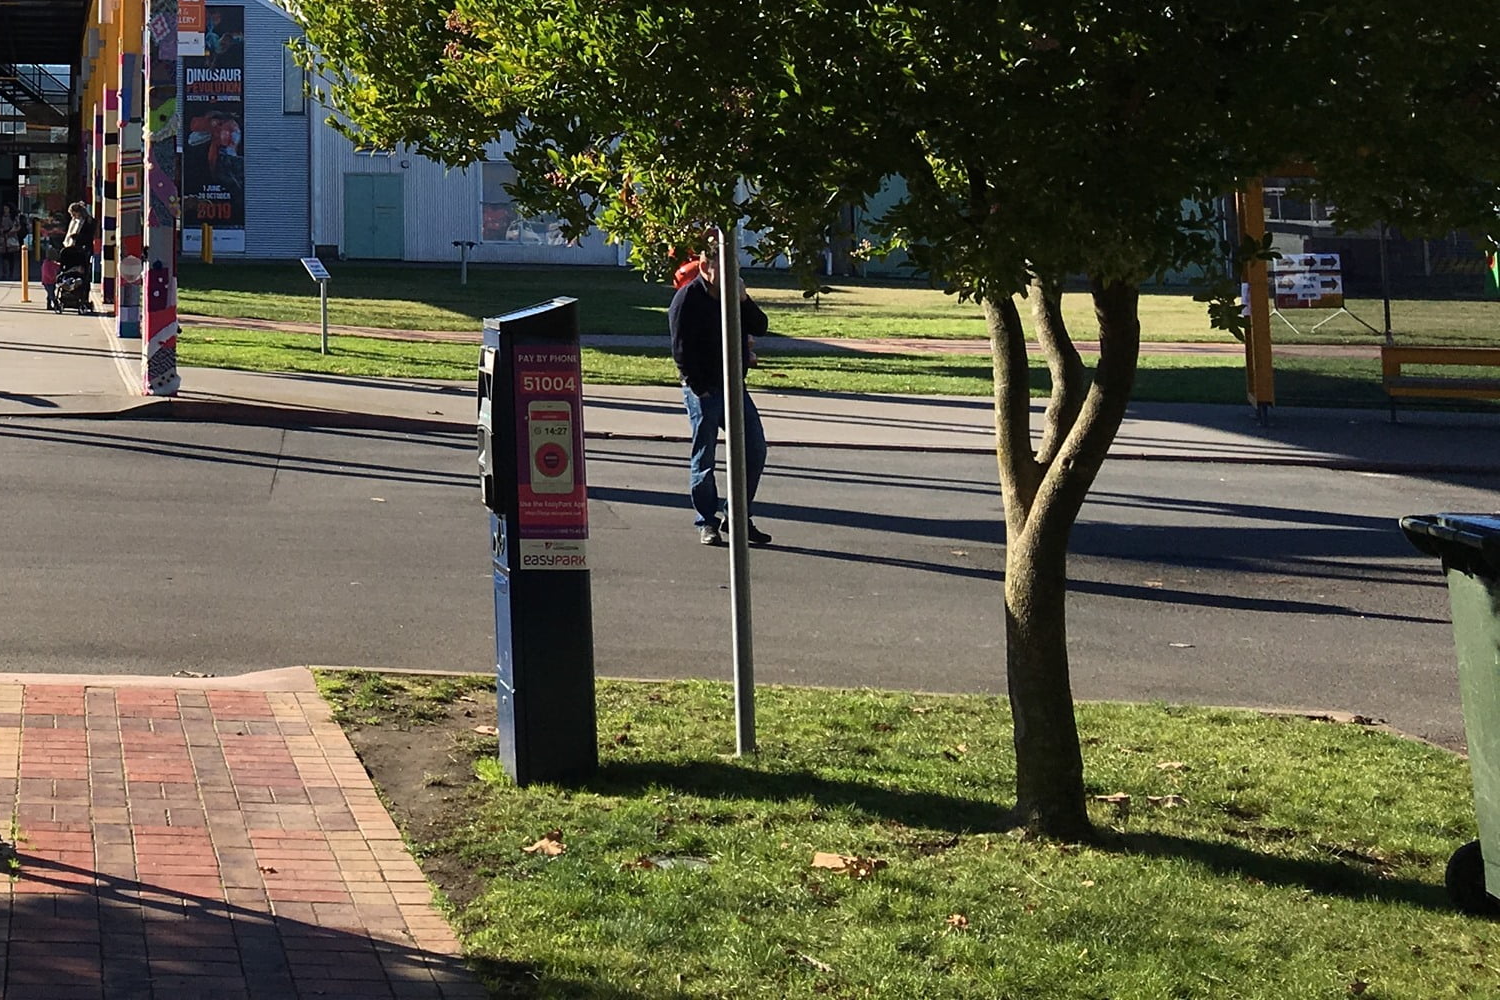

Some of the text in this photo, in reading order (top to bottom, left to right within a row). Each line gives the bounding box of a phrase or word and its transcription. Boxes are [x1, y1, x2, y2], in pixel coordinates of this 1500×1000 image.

[186, 68, 242, 85] DINOSAUR
[197, 202, 232, 219] 2019
[518, 354, 577, 363] PAY BY PHONE
[523, 376, 576, 391] 51004
[544, 427, 568, 436] 14:27
